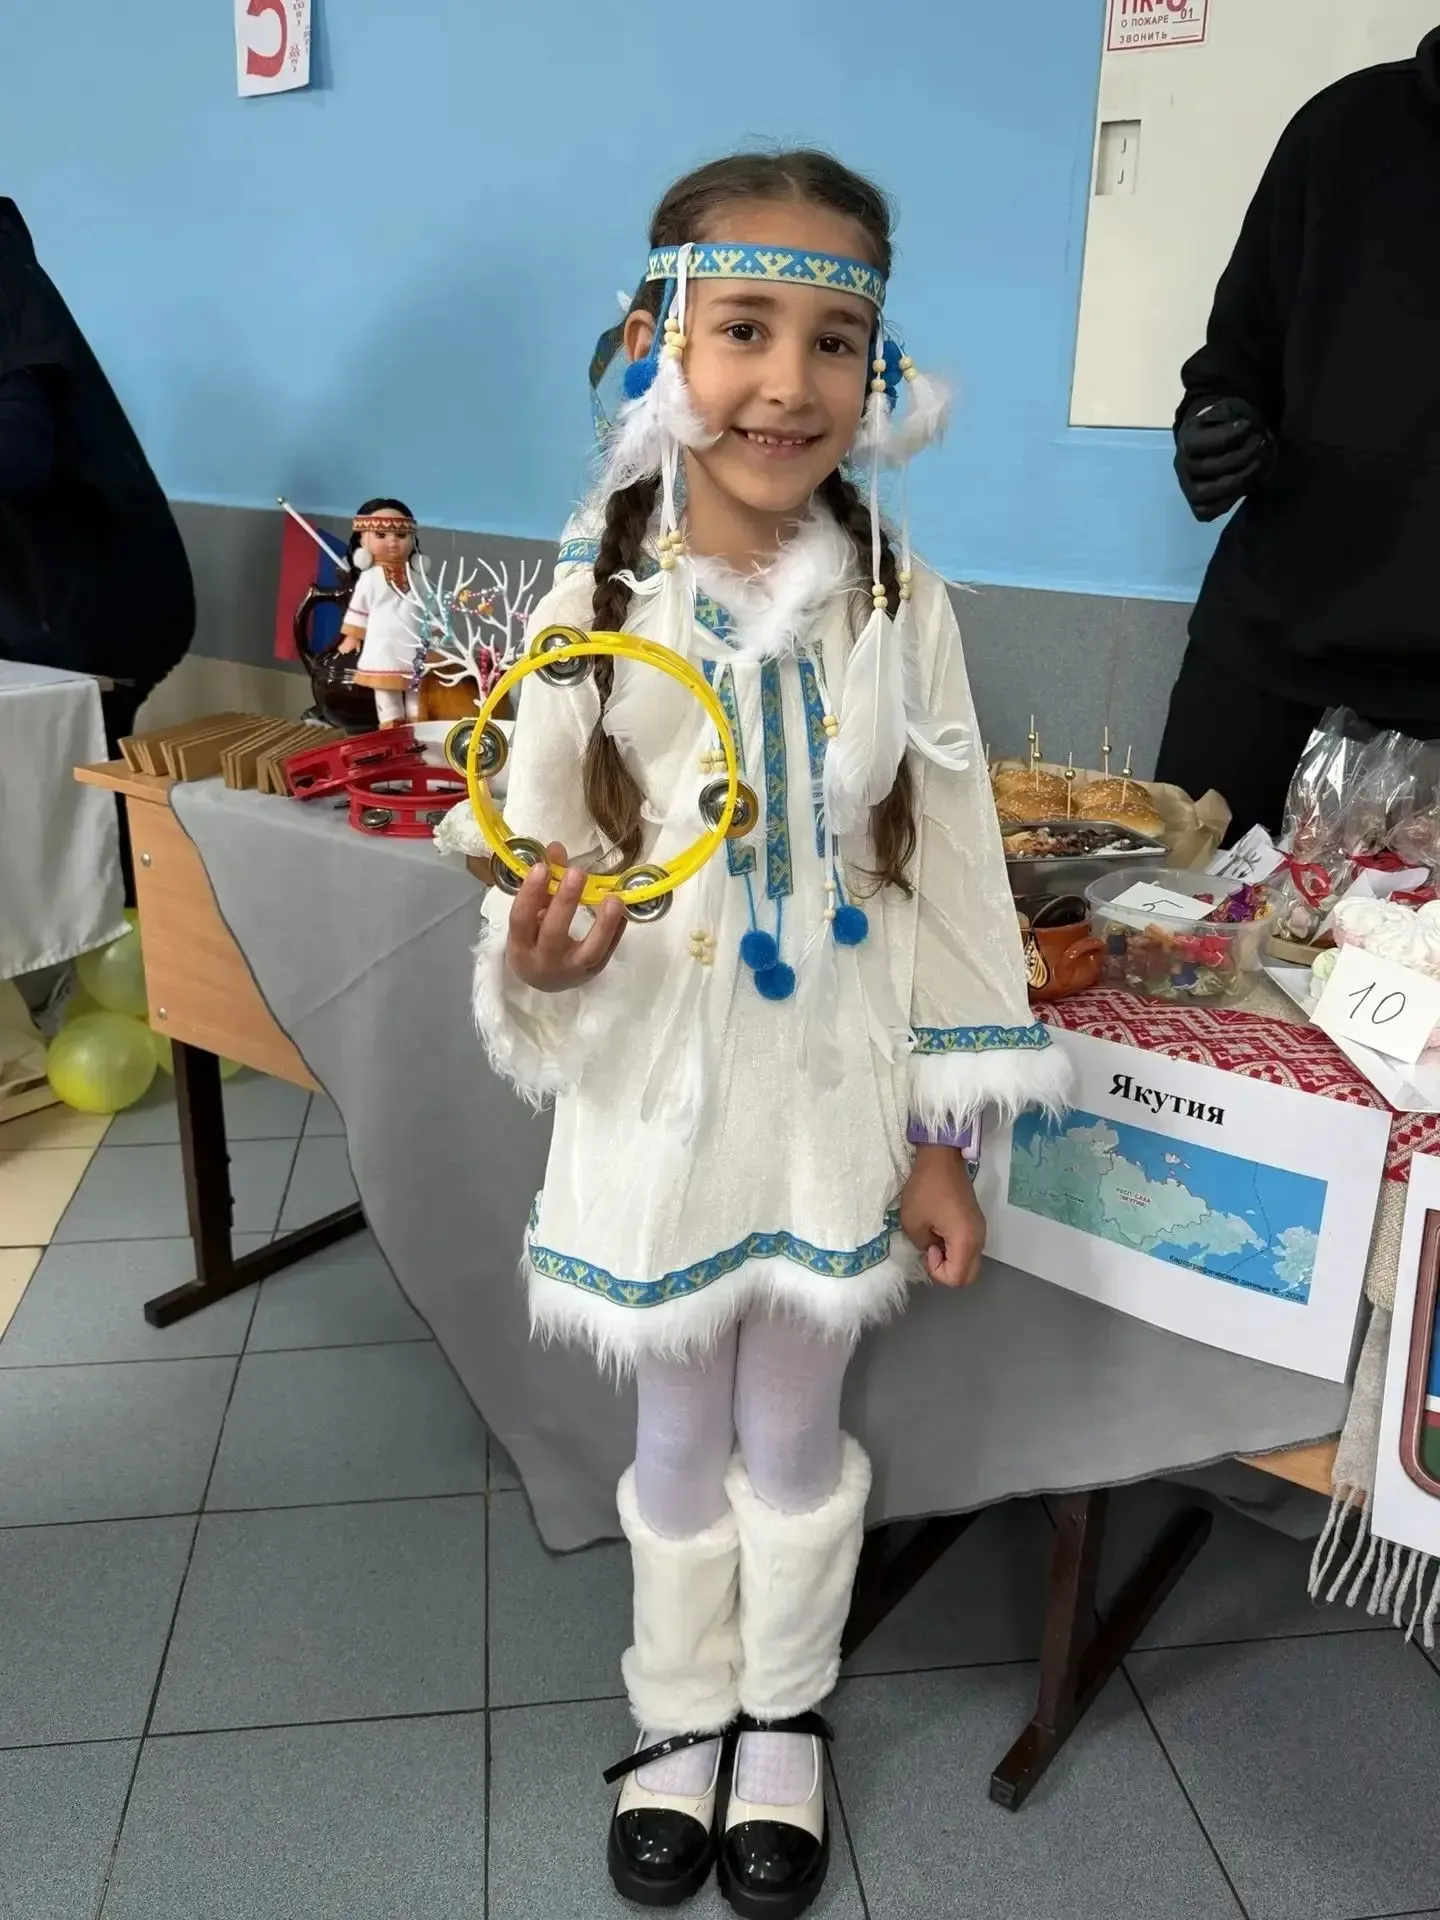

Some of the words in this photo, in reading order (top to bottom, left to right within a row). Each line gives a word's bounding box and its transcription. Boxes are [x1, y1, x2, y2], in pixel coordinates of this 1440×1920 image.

[1121, 20, 1128, 28] О
[1131, 15, 1169, 27] ПОЖАРЕ
[1181, 8, 1194, 20] 01
[1119, 31, 1168, 44] ЗВОНИТЬ
[1349, 981, 1406, 1025] 10
[1108, 1073, 1225, 1126] Якутия
